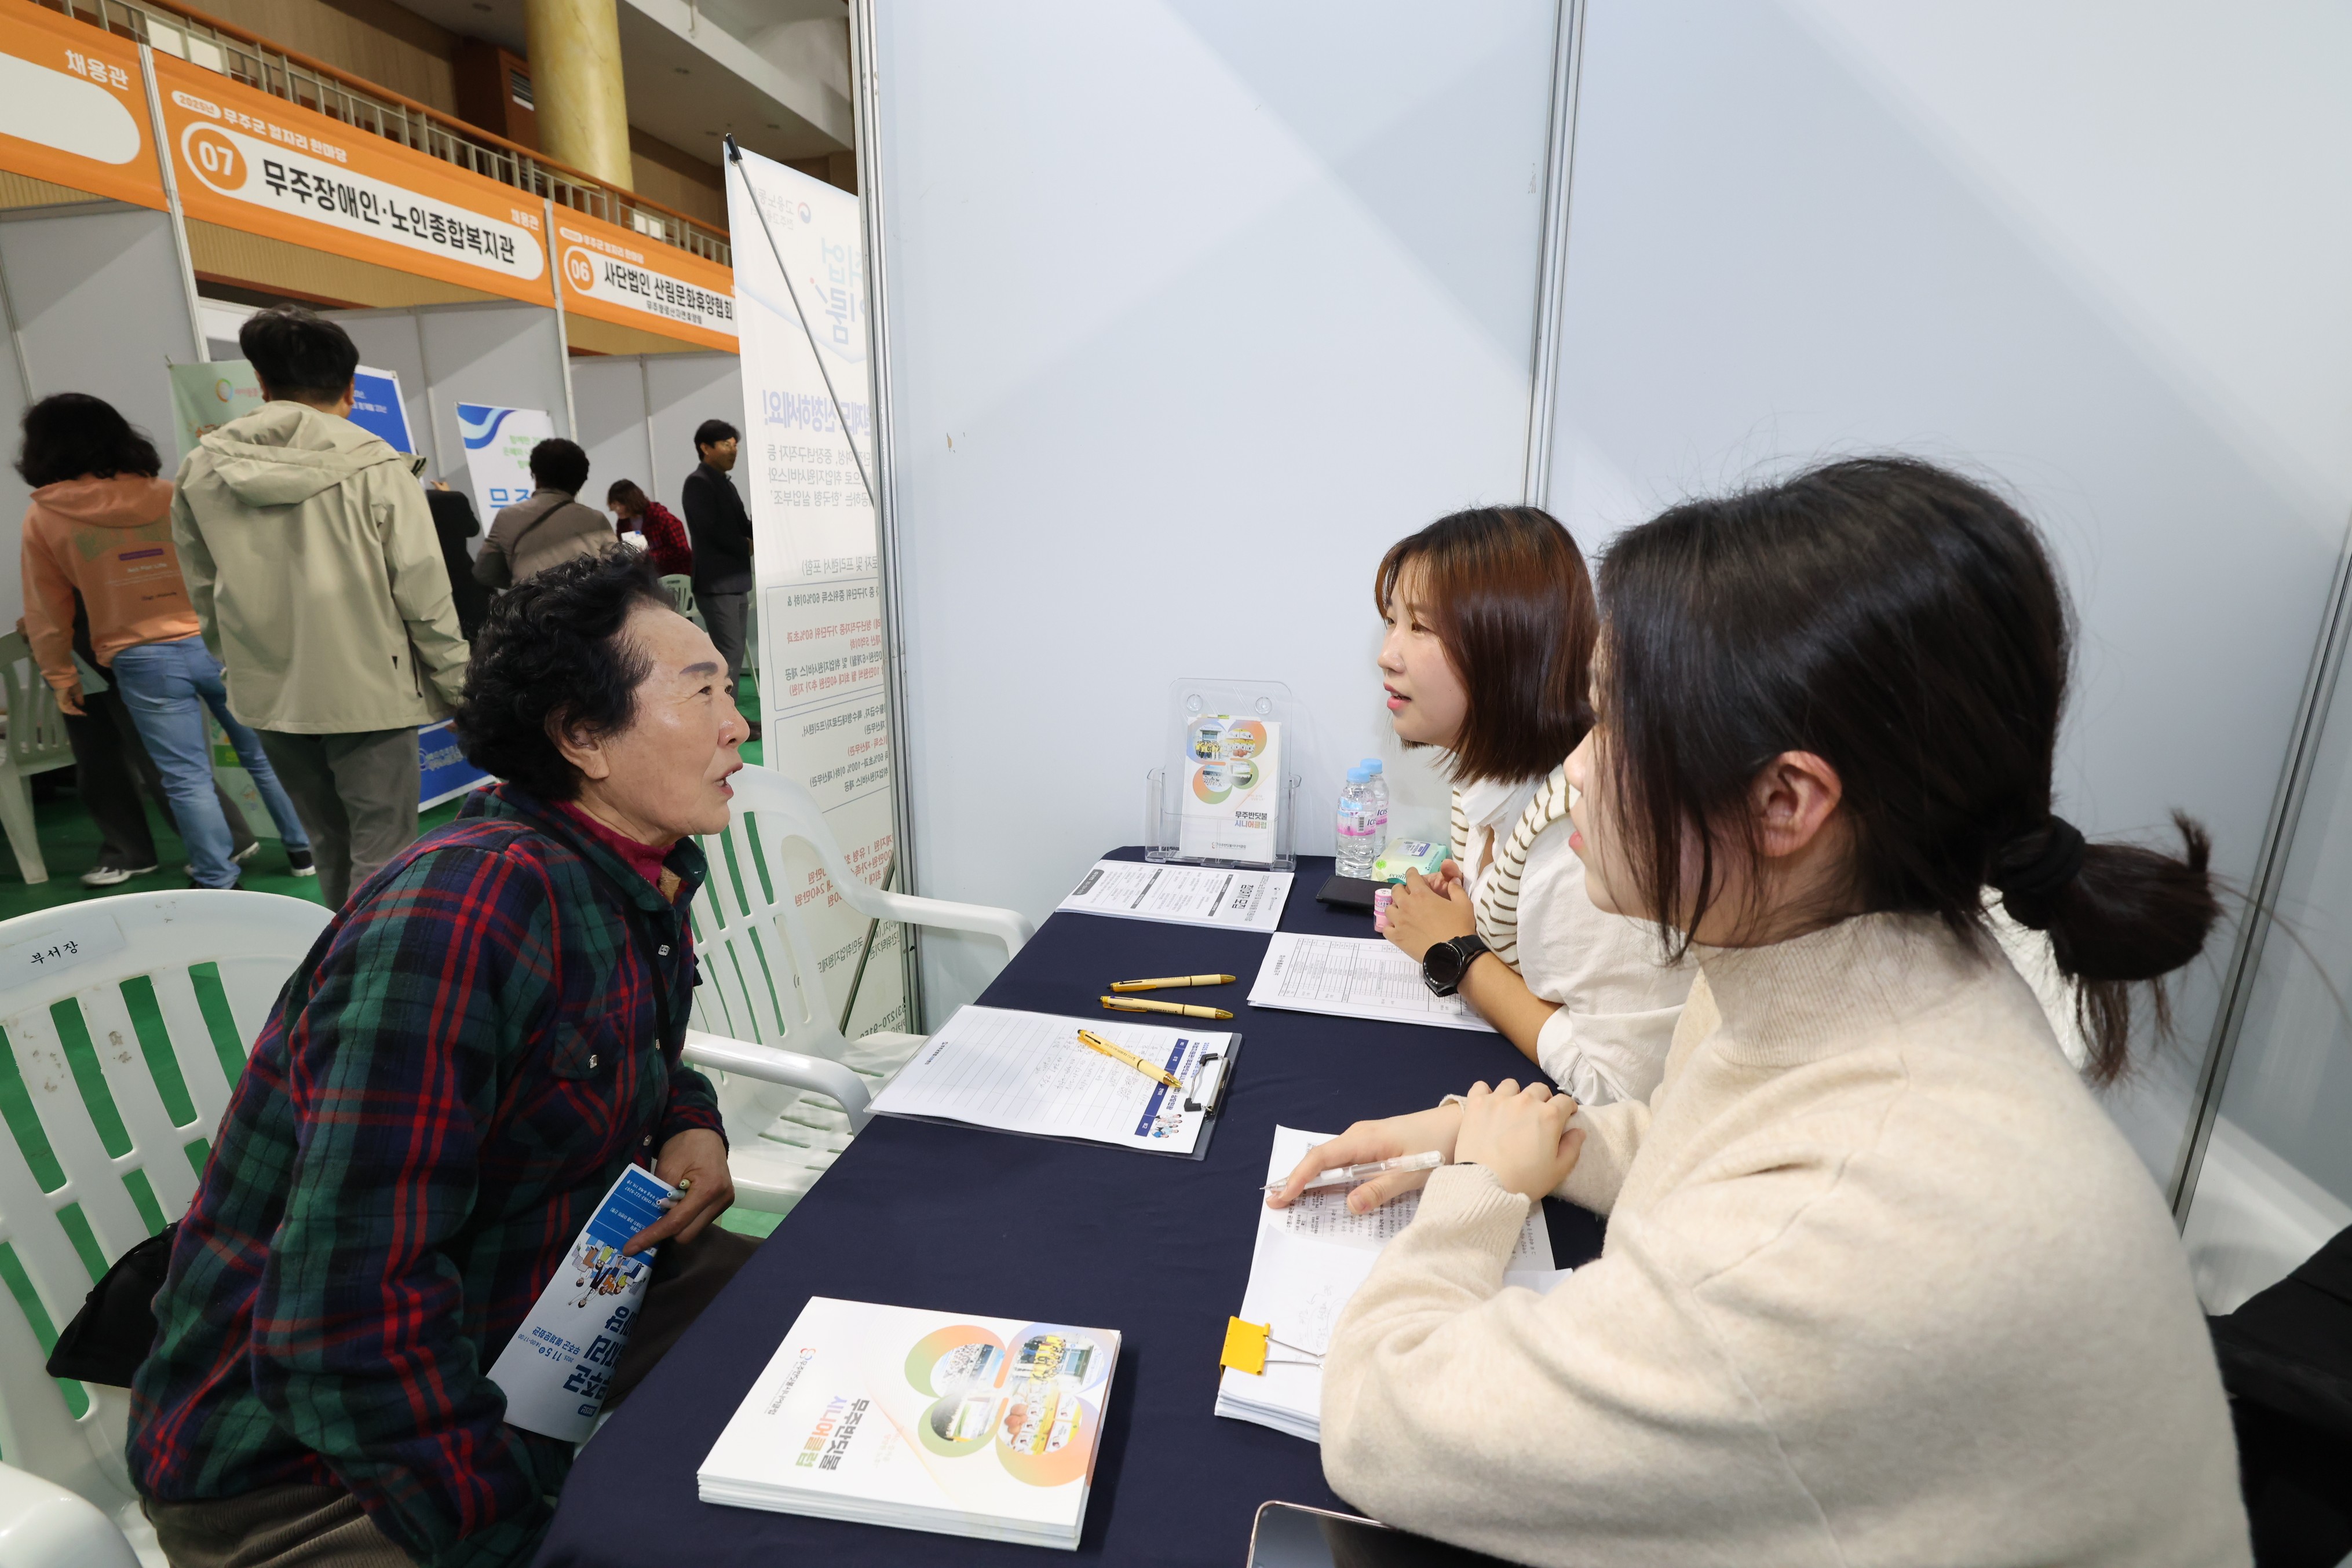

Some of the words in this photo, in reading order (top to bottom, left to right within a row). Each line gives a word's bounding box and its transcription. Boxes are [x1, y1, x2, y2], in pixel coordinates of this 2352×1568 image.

[65, 49, 130, 91] 채용관
[223, 107, 266, 136] 무주군
[268, 122, 308, 151] 일자리
[310, 138, 348, 163] 한마당
[199, 140, 235, 176] 07
[264, 158, 515, 264] 무주장애인·노인종합복지관
[510, 209, 540, 231] 채용관
[571, 262, 590, 282] 06
[604, 261, 651, 296] 사단법인
[654, 280, 734, 321] 산림문화휴양협회
[1235, 810, 1268, 821] 무주반딧불
[1235, 820, 1268, 829] 시니어클럽
[1236, 883, 1254, 899] 참여자
[1231, 898, 1248, 909] 모집
[30, 941, 78, 964] 부서장
[624, 1186, 649, 1202] 063-322-9297
[517, 1333, 542, 1348] 14:00-17:00
[532, 1326, 562, 1346] 예체문화관
[563, 1341, 581, 1355] 무주군
[563, 1354, 574, 1362] 2025.
[796, 1395, 848, 1468] 시니어클럽
[819, 1398, 870, 1472] 무주반딧불
